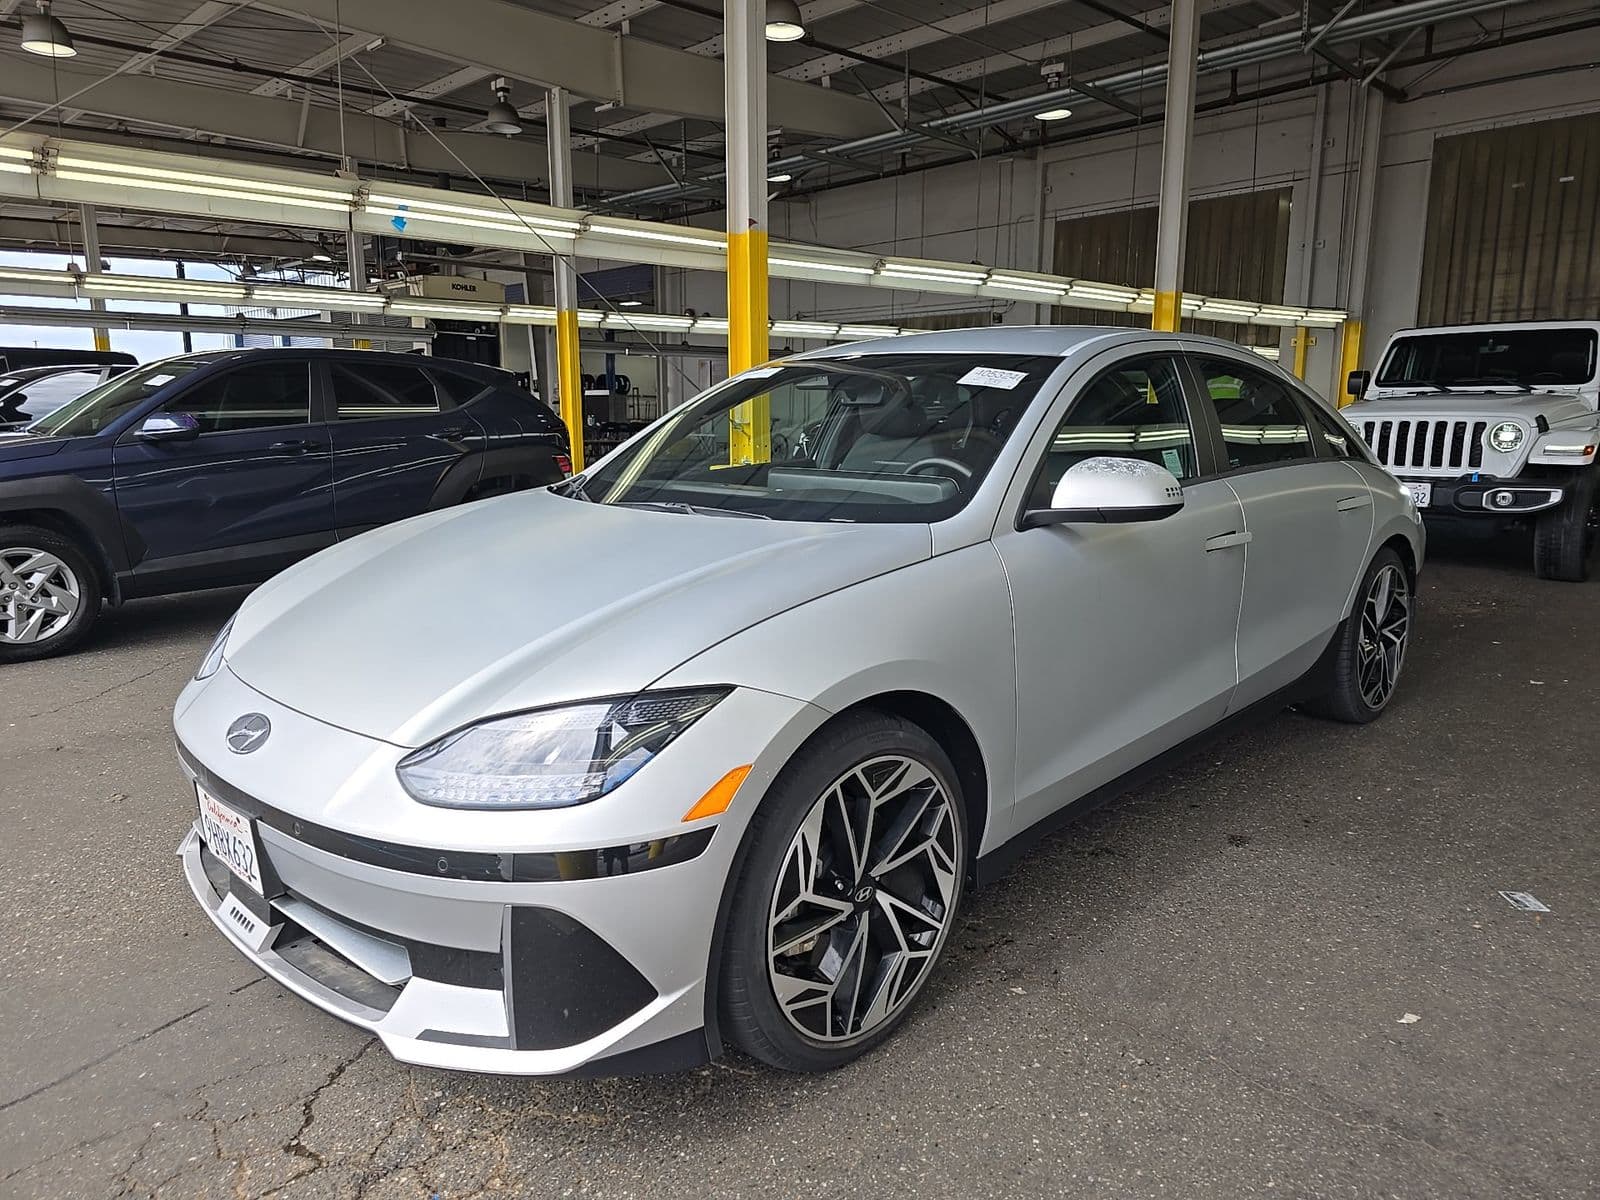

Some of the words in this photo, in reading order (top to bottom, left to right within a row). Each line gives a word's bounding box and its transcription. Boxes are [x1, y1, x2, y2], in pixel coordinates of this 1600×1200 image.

[451, 283, 477, 292] KOHLER
[207, 801, 238, 828] California
[204, 814, 257, 881] 9HBX632
